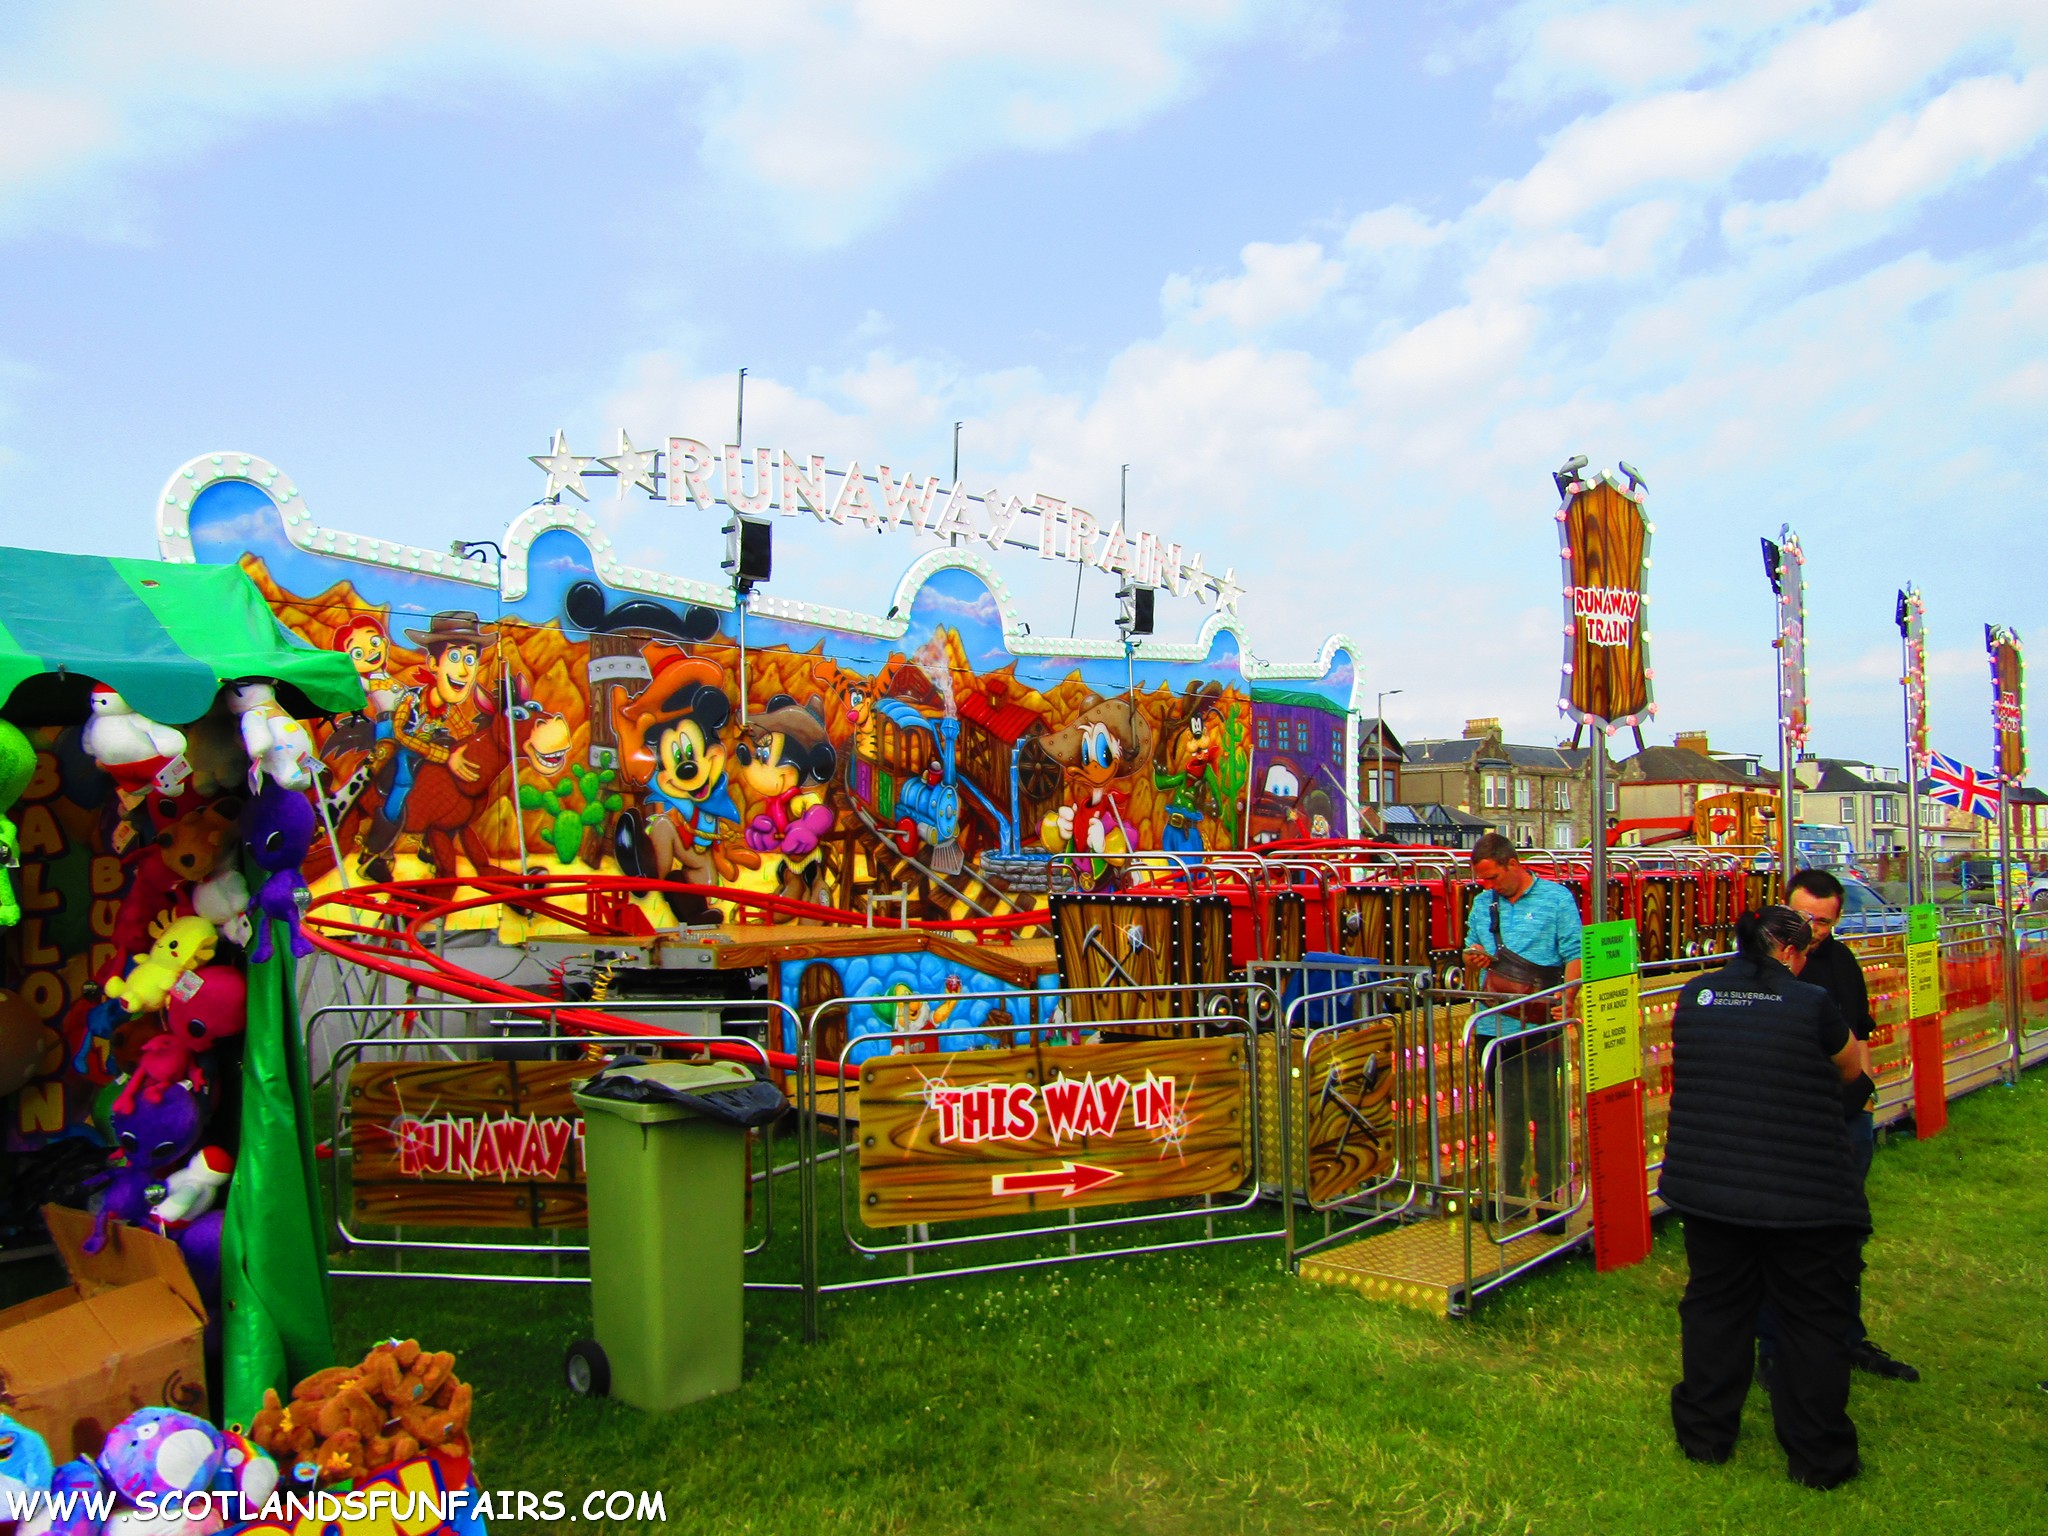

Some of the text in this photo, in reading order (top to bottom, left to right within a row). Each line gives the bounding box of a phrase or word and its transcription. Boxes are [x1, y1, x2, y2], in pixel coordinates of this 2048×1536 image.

[665, 436, 1182, 598] RUNAWAY TRAIN
[1574, 586, 1639, 621] RUNAWAY
[1586, 617, 1629, 646] TRAIN
[2002, 691, 2015, 705] FOR
[1600, 934, 1624, 946] RUNAWAY
[1606, 949, 1620, 960] TRAIN
[1713, 998, 1753, 1006] SECURITY
[1730, 991, 1783, 1002] SILVERBACK
[1613, 999, 1627, 1009] ADULT
[1603, 1026, 1626, 1038] ALL RIDERS
[931, 1068, 1175, 1147] THIS WAY IN
[400, 1110, 572, 1183] RUNAWAY
